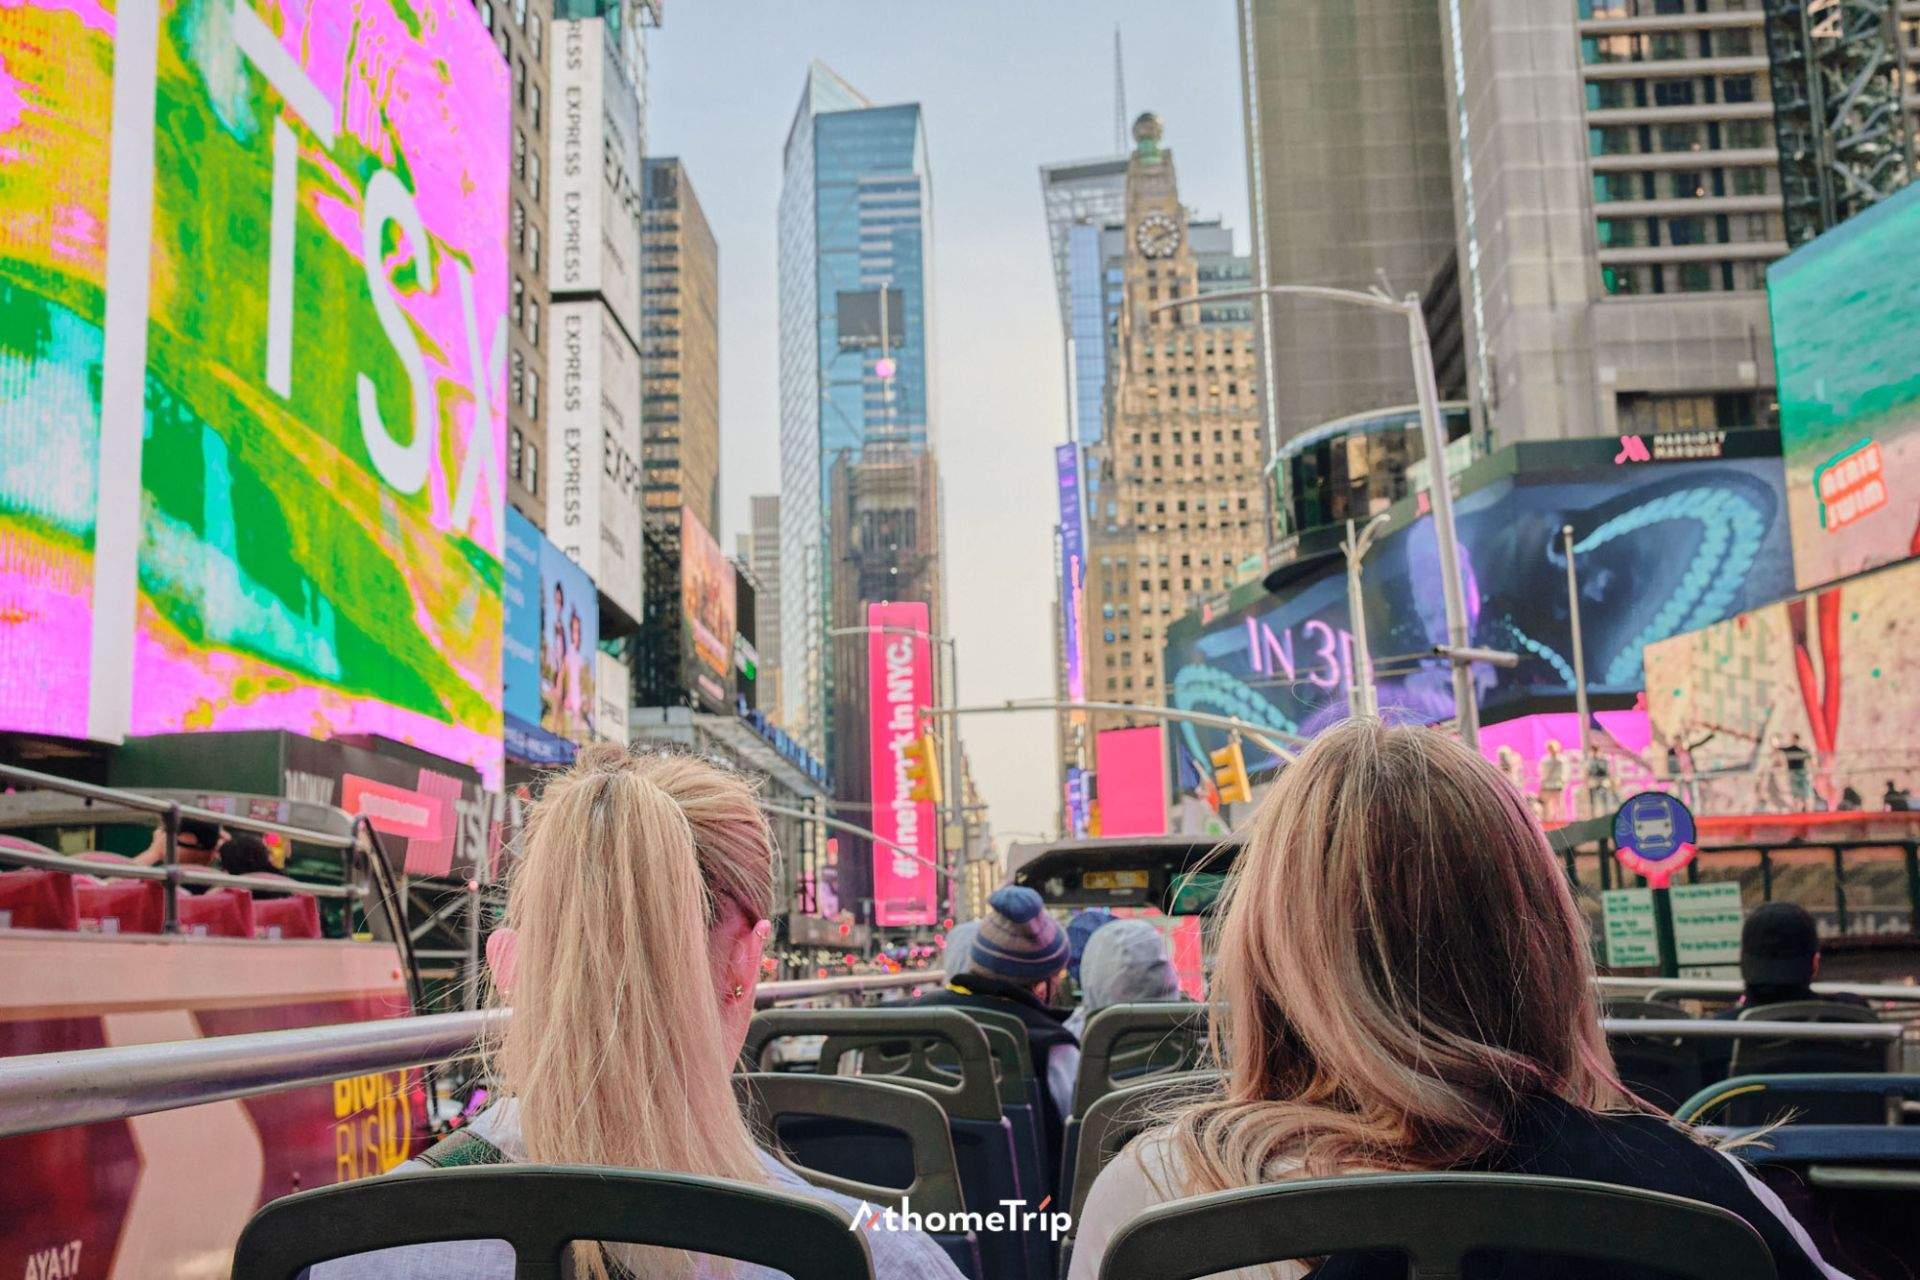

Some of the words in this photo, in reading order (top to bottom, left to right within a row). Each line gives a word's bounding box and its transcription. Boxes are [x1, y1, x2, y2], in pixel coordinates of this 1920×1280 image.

[565, 86, 581, 177] EXPRESS
[564, 192, 580, 282] EXPRESS
[564, 315, 580, 412] EXPRESS
[564, 428, 580, 526] EXPRESS
[886, 636, 914, 703] NYC.
[1246, 616, 1296, 682] IN
[888, 706, 914, 731] in
